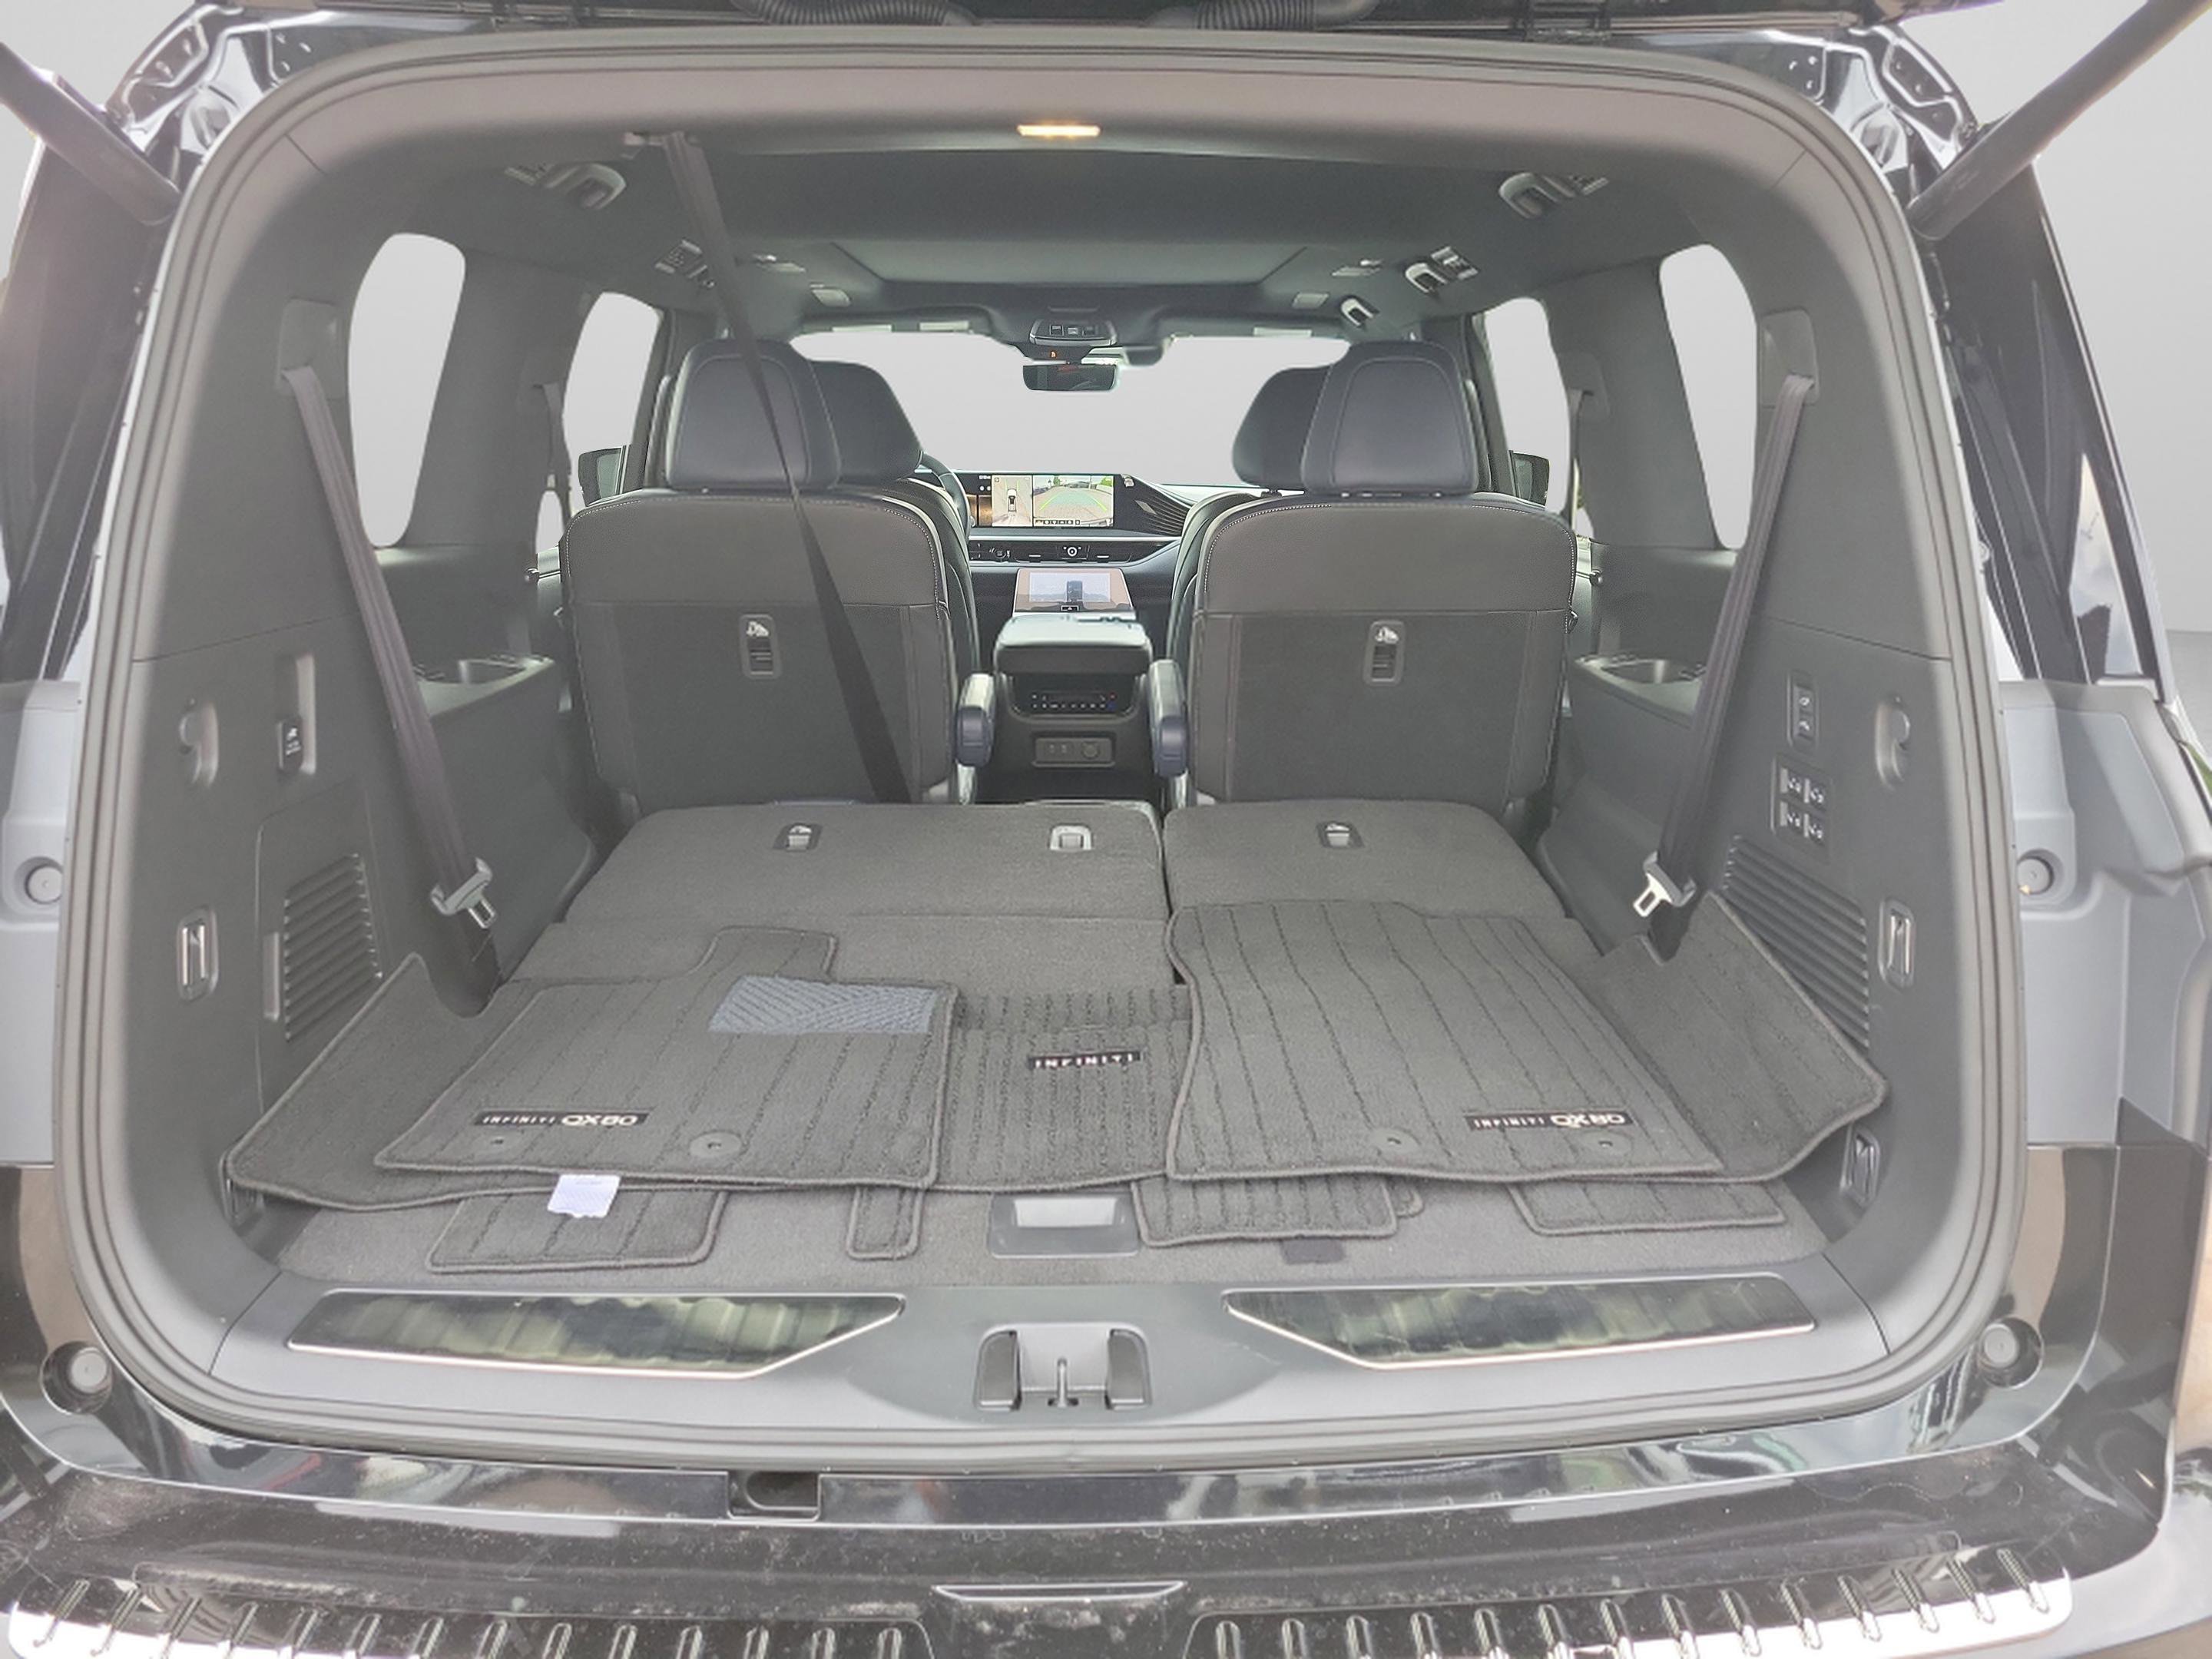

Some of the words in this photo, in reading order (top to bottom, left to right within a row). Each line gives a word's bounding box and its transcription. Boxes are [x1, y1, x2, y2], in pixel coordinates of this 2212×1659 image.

[1035, 1053, 1133, 1068] INFINITI
[482, 1115, 555, 1124] INFINITI
[561, 1114, 638, 1126] QX80
[1474, 1116, 1545, 1129] INFINITI
[1550, 1113, 1625, 1128] QX80
